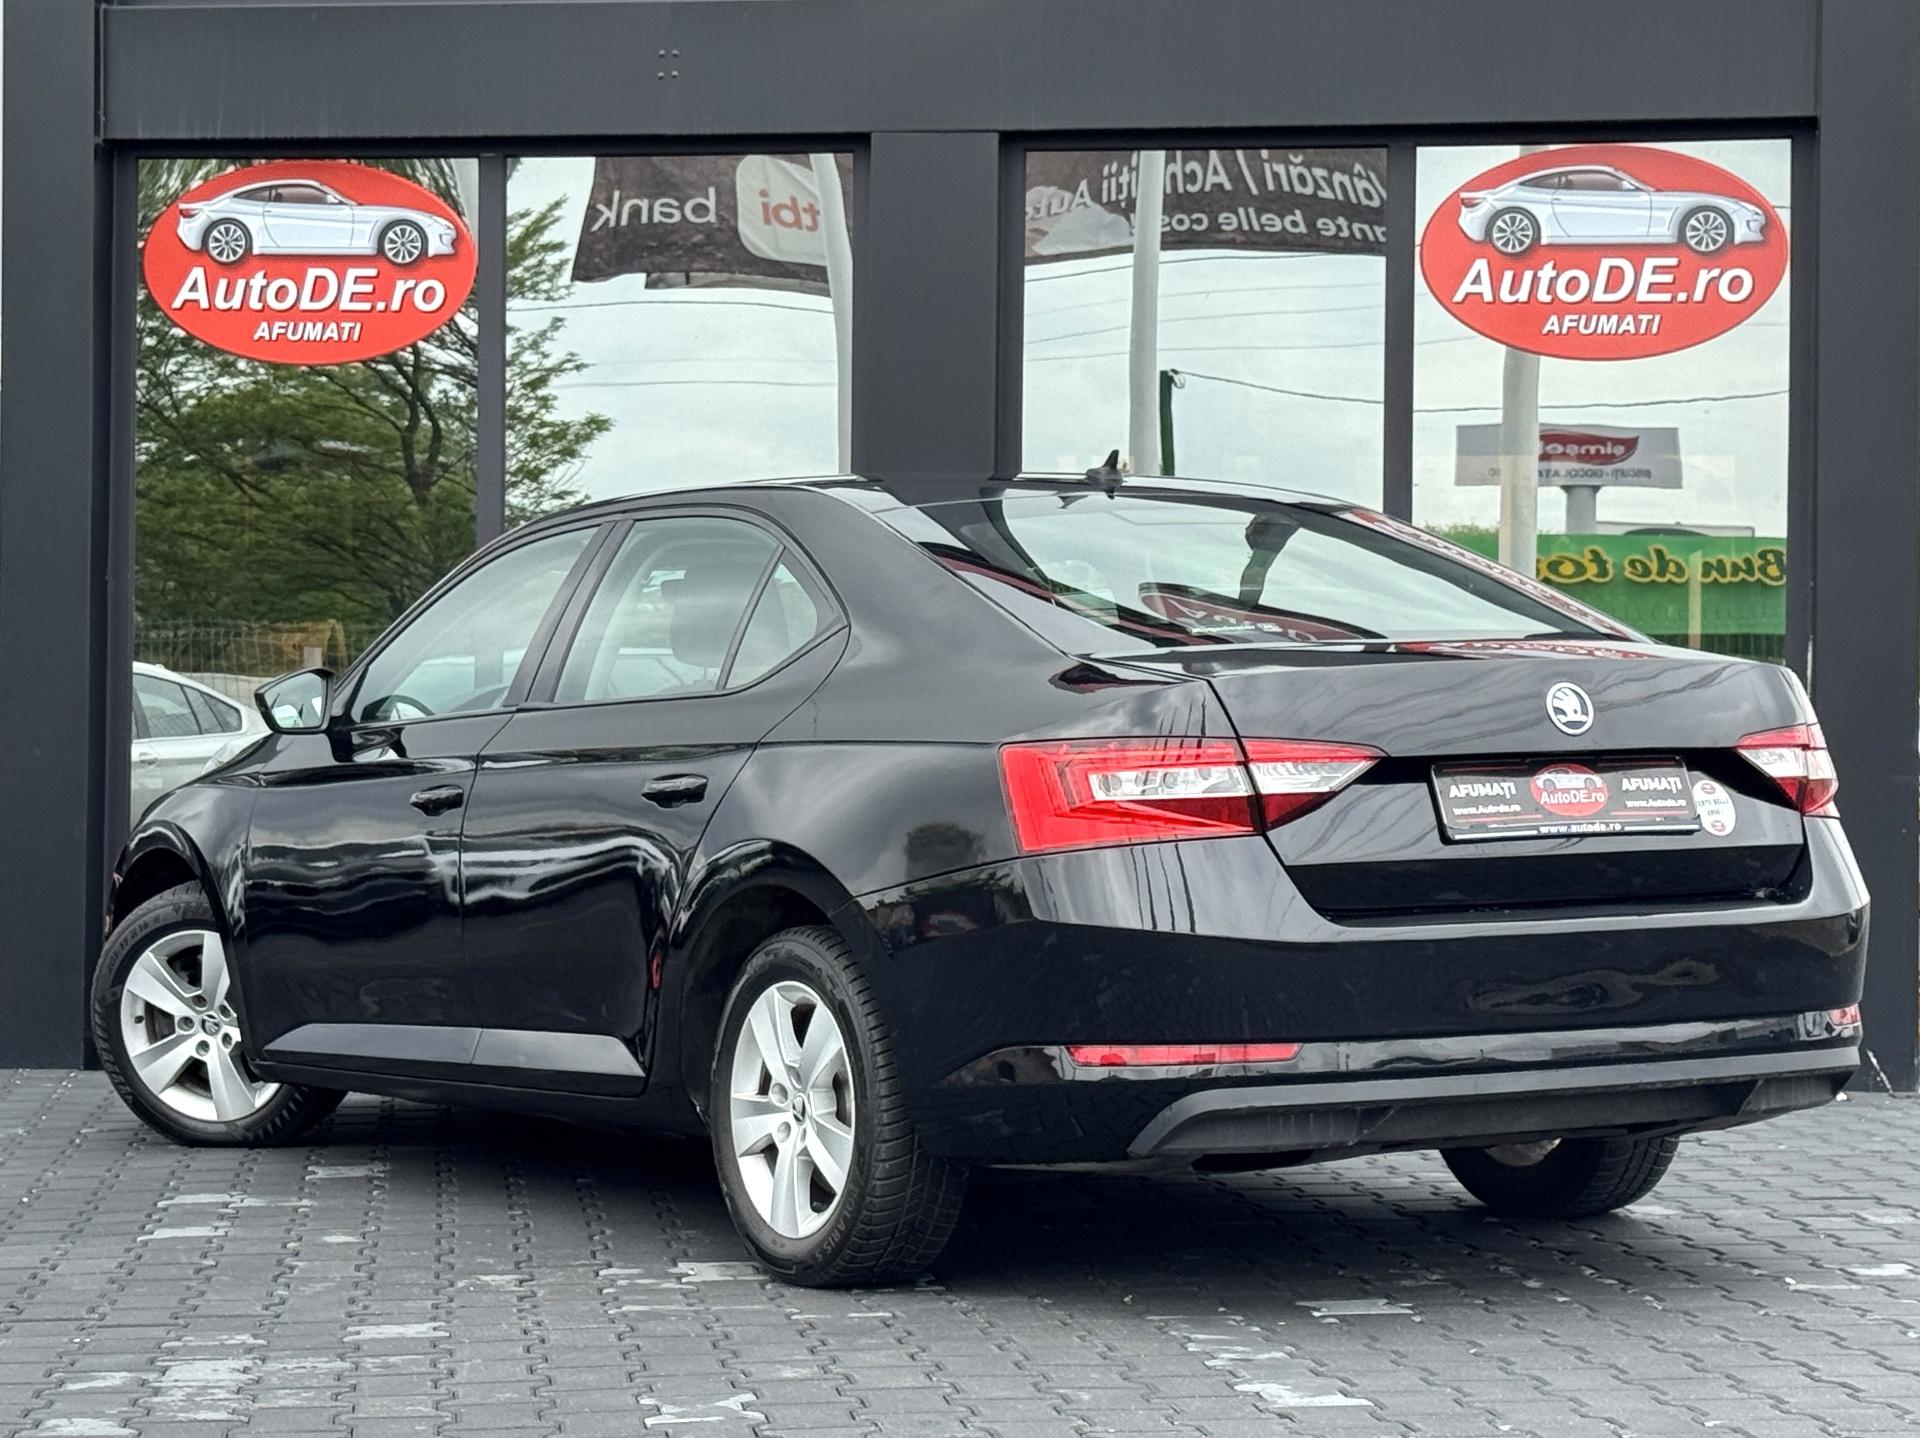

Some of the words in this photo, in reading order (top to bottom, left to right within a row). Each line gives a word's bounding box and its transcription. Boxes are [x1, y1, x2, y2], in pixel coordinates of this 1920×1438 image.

[171, 266, 448, 312] AutoDE.ro
[1451, 257, 1755, 303] AutoDE.ro
[253, 321, 362, 342] AFUMATI
[1541, 314, 1661, 335] AFUMATI
[1540, 790, 1605, 804] AutoDE.ro
